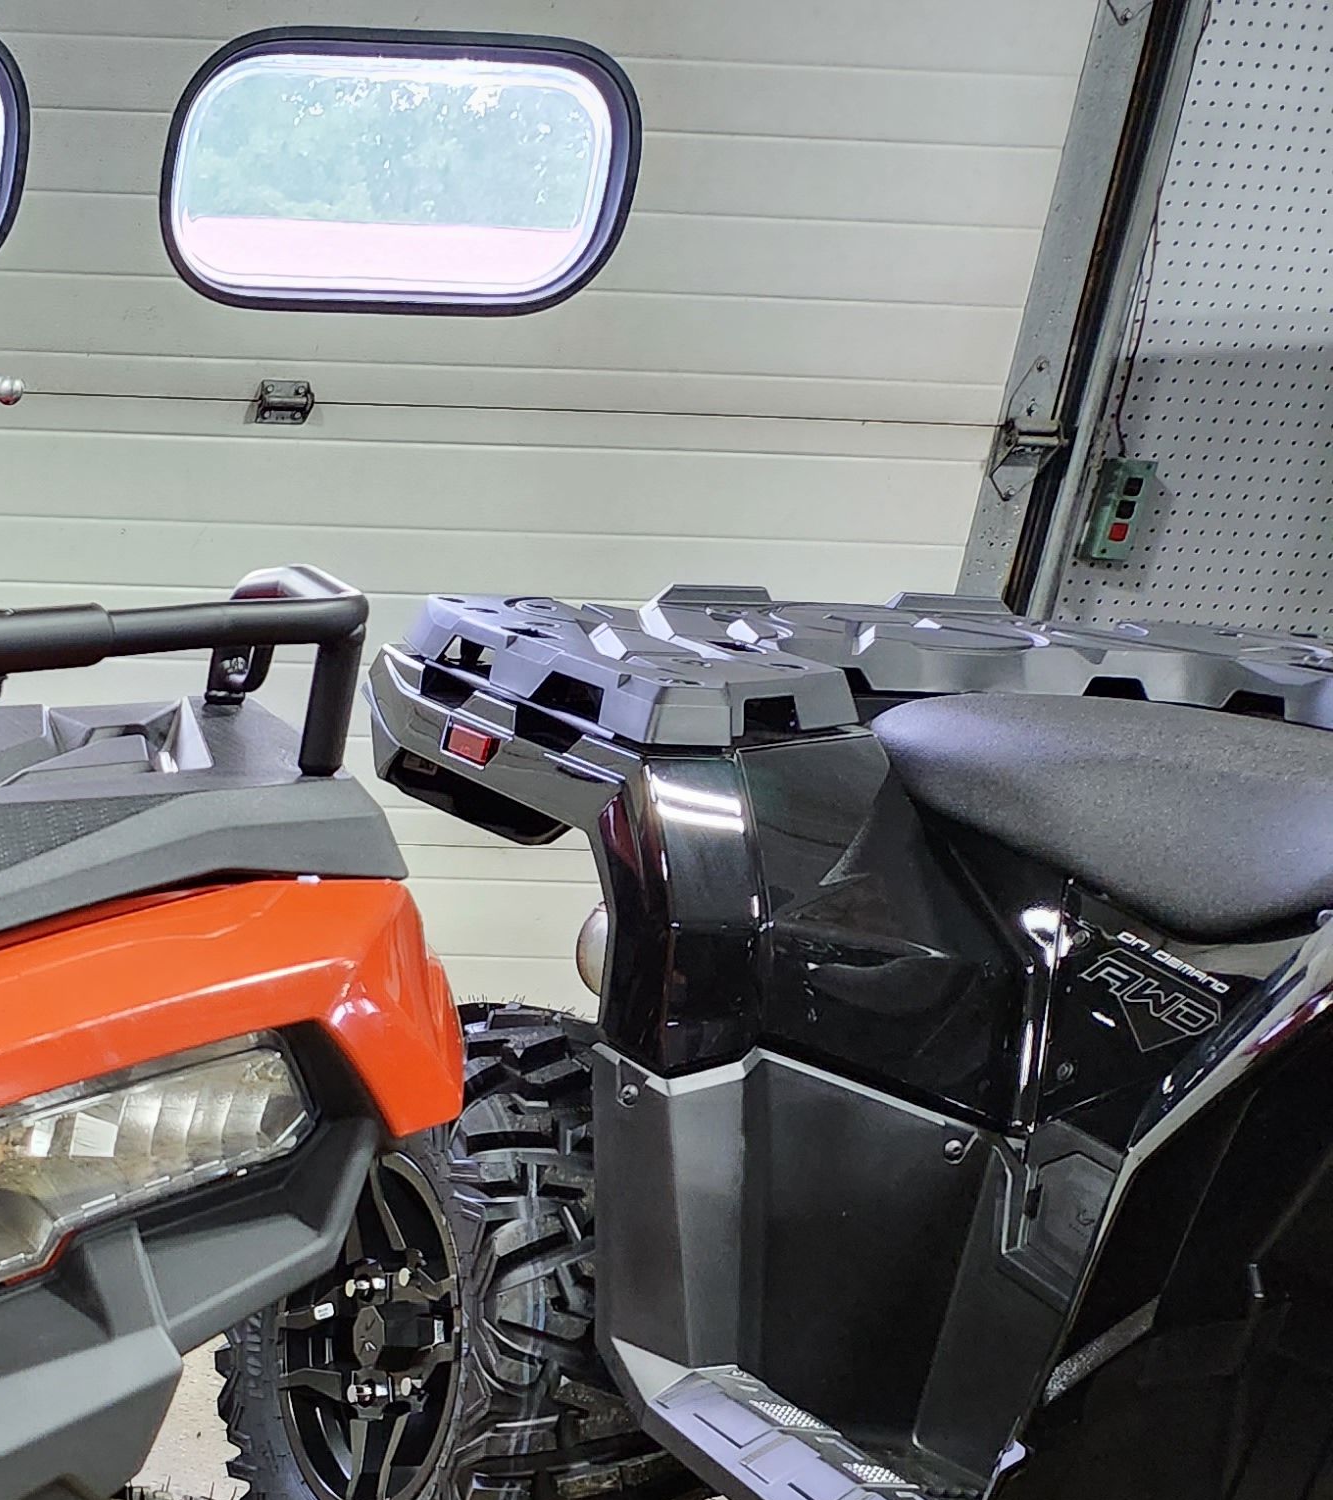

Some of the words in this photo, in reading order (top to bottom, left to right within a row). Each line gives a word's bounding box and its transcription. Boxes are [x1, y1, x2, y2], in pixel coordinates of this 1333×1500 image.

[1080, 956, 1218, 1036] AWD
[1116, 930, 1151, 952] ON
[1151, 949, 1231, 994] DEMAND
